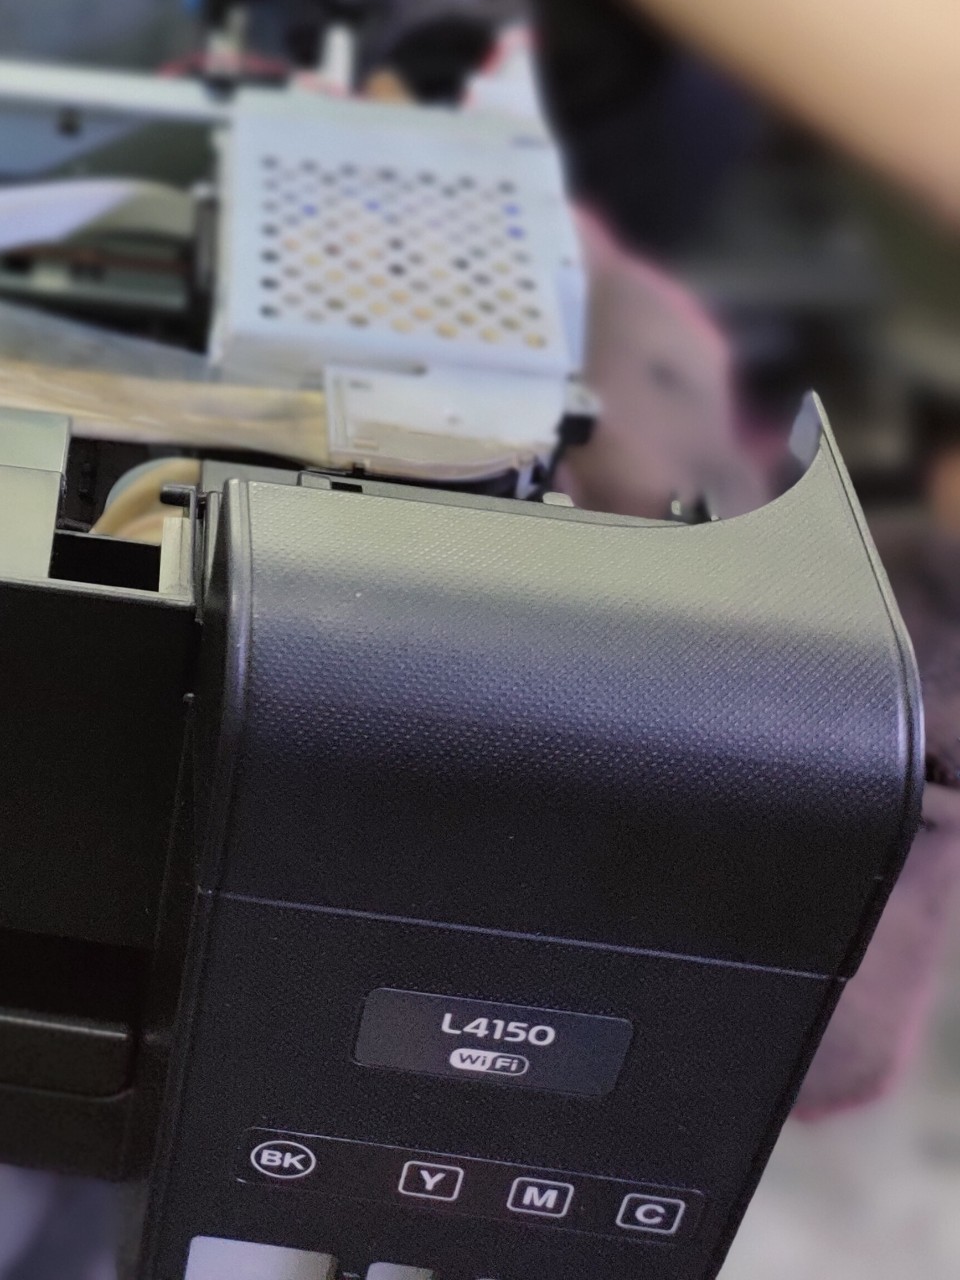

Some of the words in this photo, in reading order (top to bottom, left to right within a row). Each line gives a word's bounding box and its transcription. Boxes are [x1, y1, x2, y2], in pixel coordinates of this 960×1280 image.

[440, 1012, 556, 1046] L4150
[259, 1149, 306, 1170] BK
[420, 1169, 446, 1191] Y
[522, 1186, 557, 1209] M
[635, 1204, 666, 1225] C
